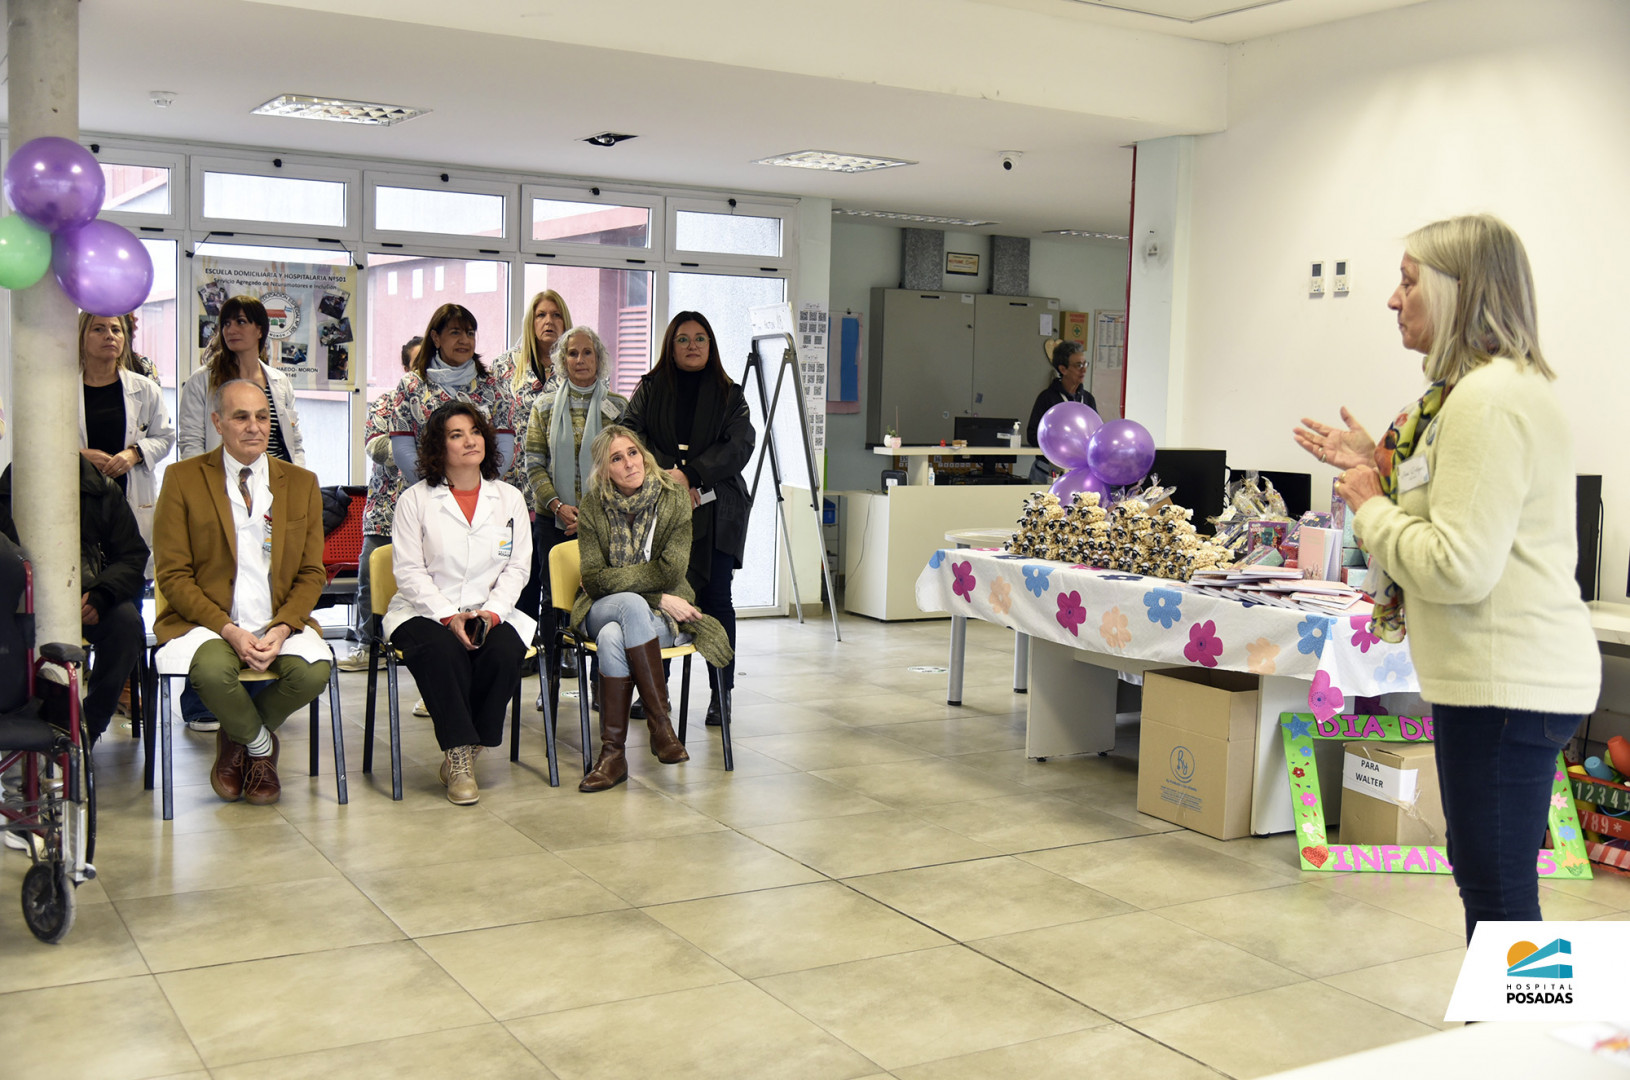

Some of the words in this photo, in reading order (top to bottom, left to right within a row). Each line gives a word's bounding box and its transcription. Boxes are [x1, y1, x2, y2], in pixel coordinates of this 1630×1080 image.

[205, 268, 232, 276] ESCUELA
[233, 270, 277, 278] DOMICILIARIA
[283, 273, 327, 281] HOSPITALARIA
[236, 279, 262, 287] Agregado
[1316, 714, 1385, 738] DIA
[1361, 759, 1380, 773] PARA
[1355, 773, 1384, 788] WALTER
